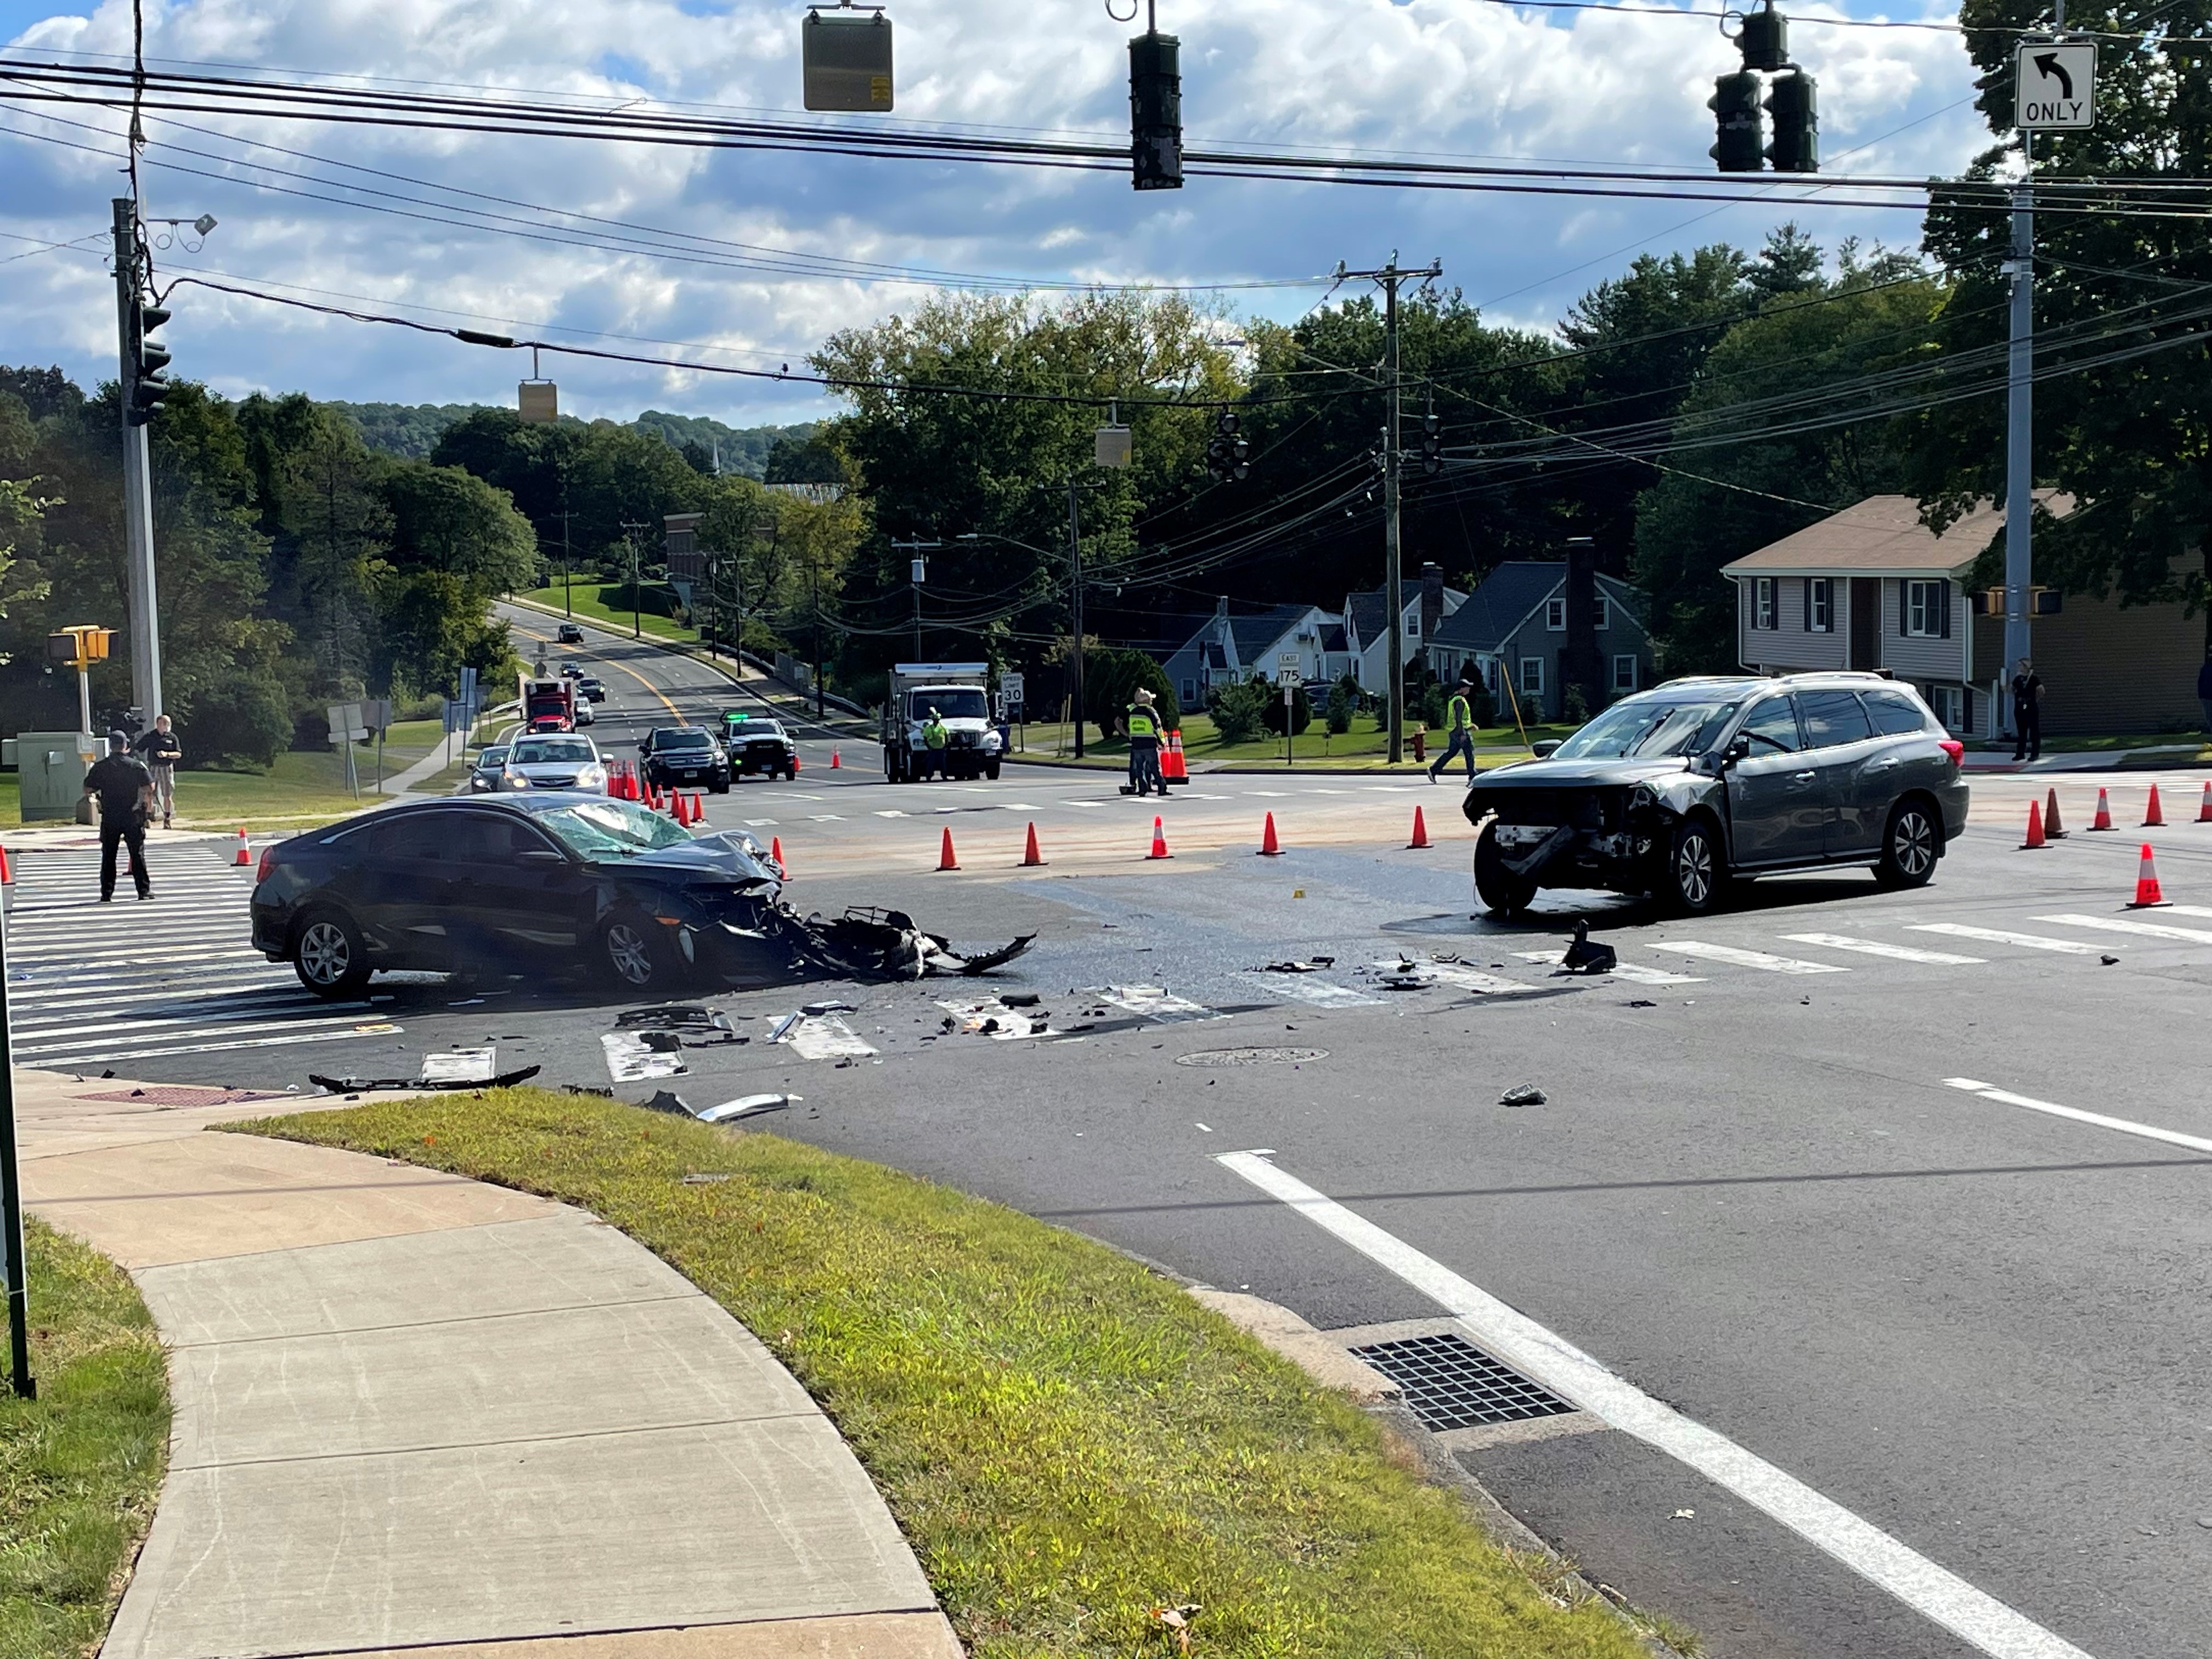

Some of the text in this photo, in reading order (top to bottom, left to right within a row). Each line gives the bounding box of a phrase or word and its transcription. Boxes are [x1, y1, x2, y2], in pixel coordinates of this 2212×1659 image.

[2027, 101, 2083, 121] ONLY
[1280, 670, 1299, 682] 175
[1005, 690, 1021, 701] 30
